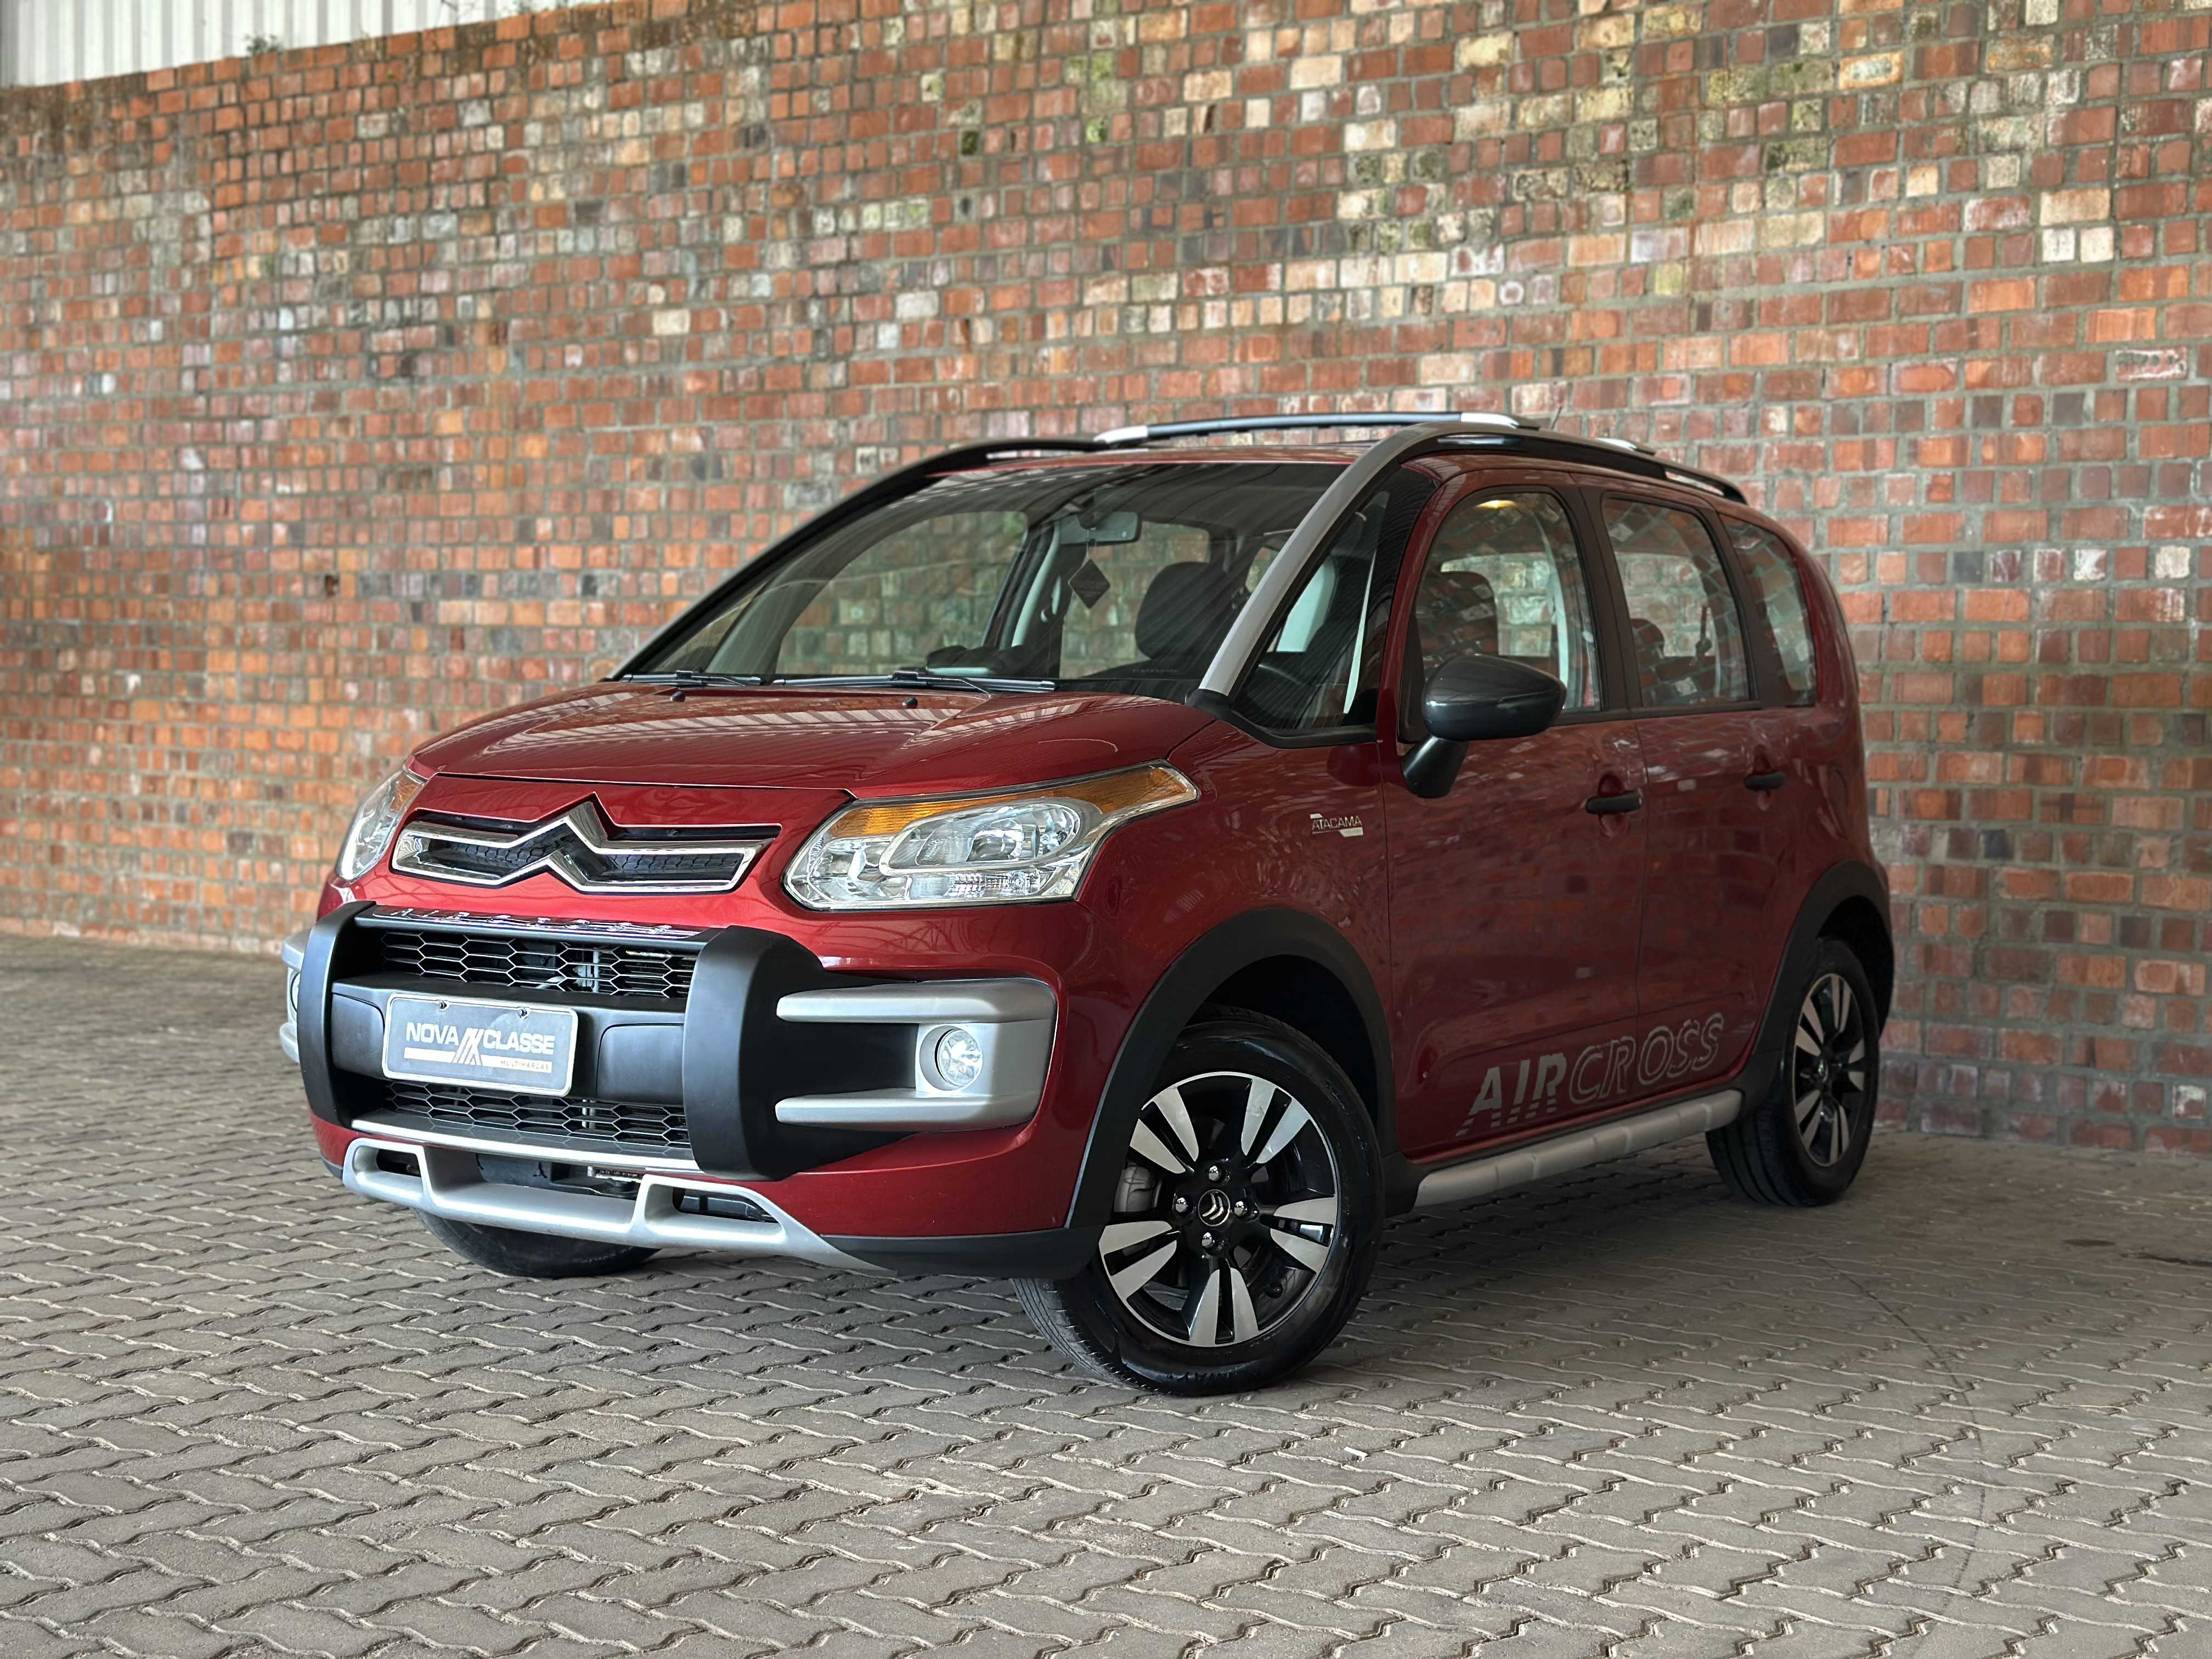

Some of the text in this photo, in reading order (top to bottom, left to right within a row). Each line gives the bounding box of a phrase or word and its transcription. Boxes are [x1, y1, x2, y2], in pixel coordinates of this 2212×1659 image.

[1312, 815, 1362, 830] ATACAMA
[405, 1022, 555, 1055] NOVA CLASSE
[1455, 1012, 1724, 1136] AIRCROSS
